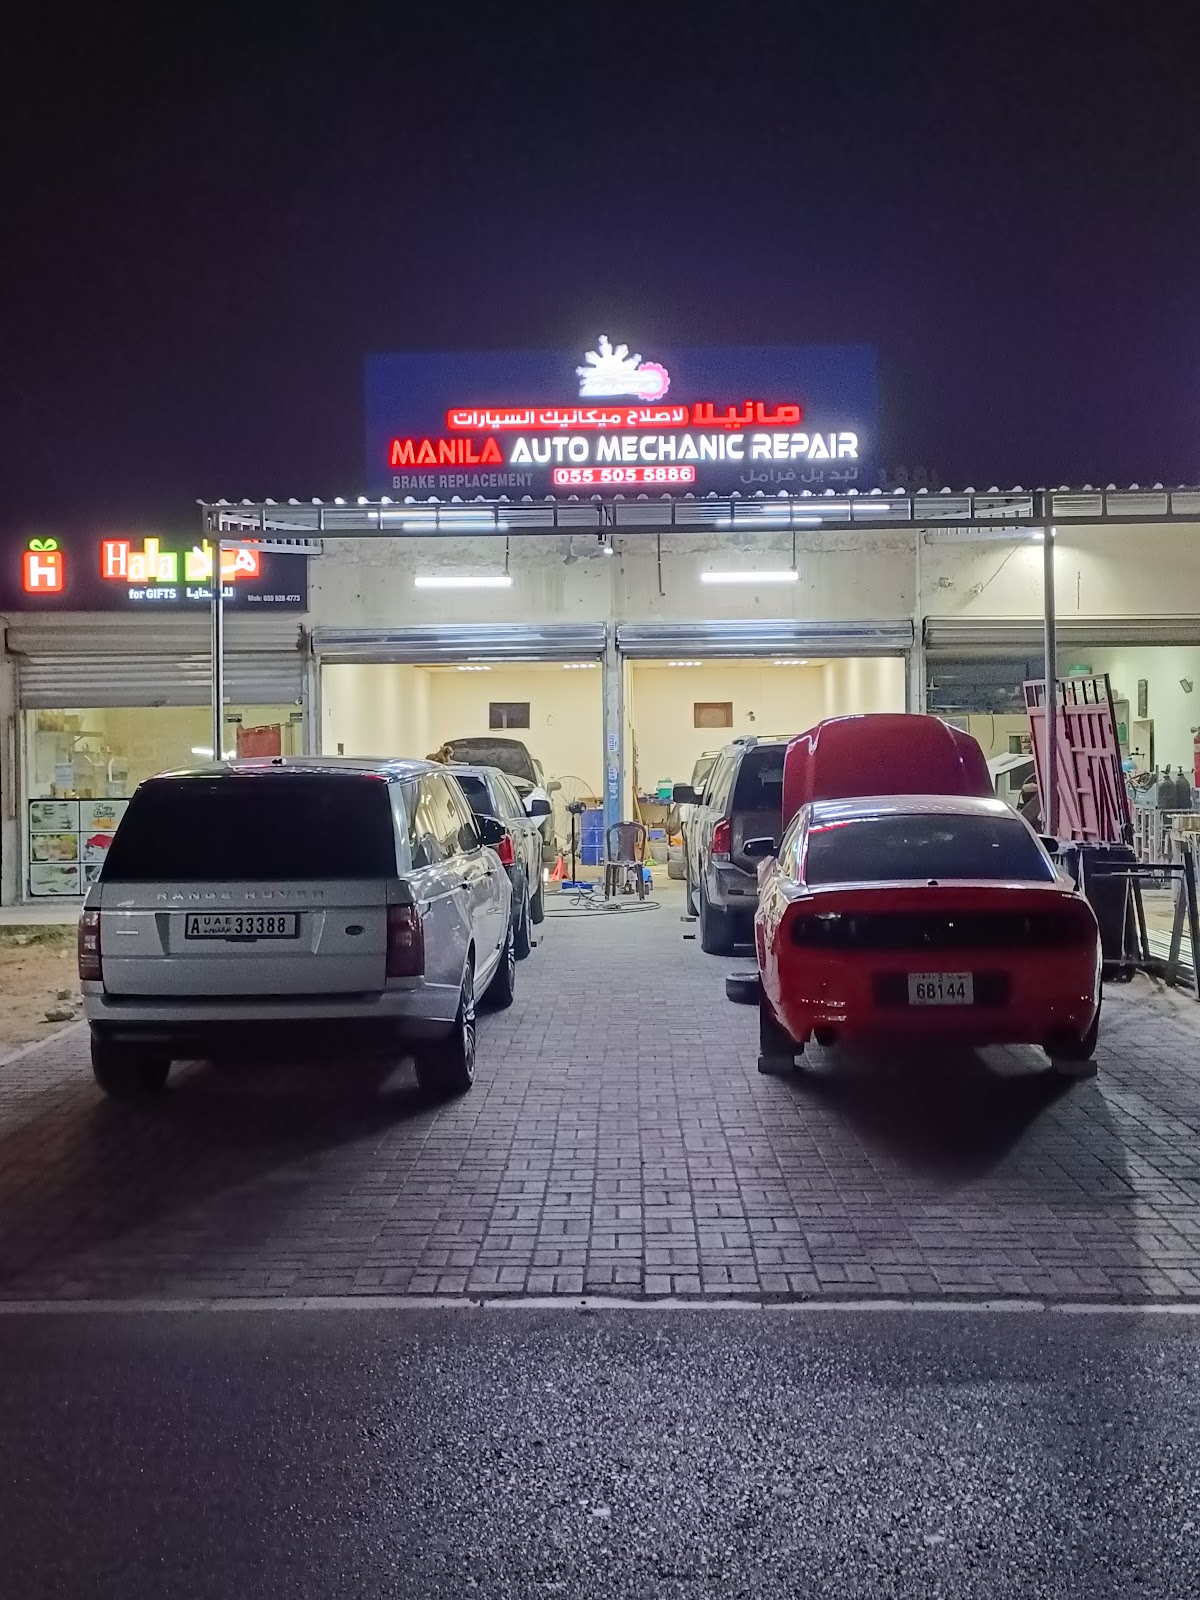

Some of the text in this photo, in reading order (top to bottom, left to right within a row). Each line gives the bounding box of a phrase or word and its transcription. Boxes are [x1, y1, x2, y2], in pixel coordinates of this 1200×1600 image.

[453, 408, 684, 428] لاصلاح ميكانيك السيارات
[693, 401, 800, 428] مانيلا
[391, 432, 859, 465] MANILA AUTO MECHANIC REPAIR
[392, 473, 533, 489] BRAKE REPLACEMENT
[557, 467, 692, 483] 055 505 5886
[128, 588, 177, 599] for GIFTS
[190, 917, 200, 934] A
[235, 917, 286, 934] 33388
[916, 982, 966, 999] 68144
